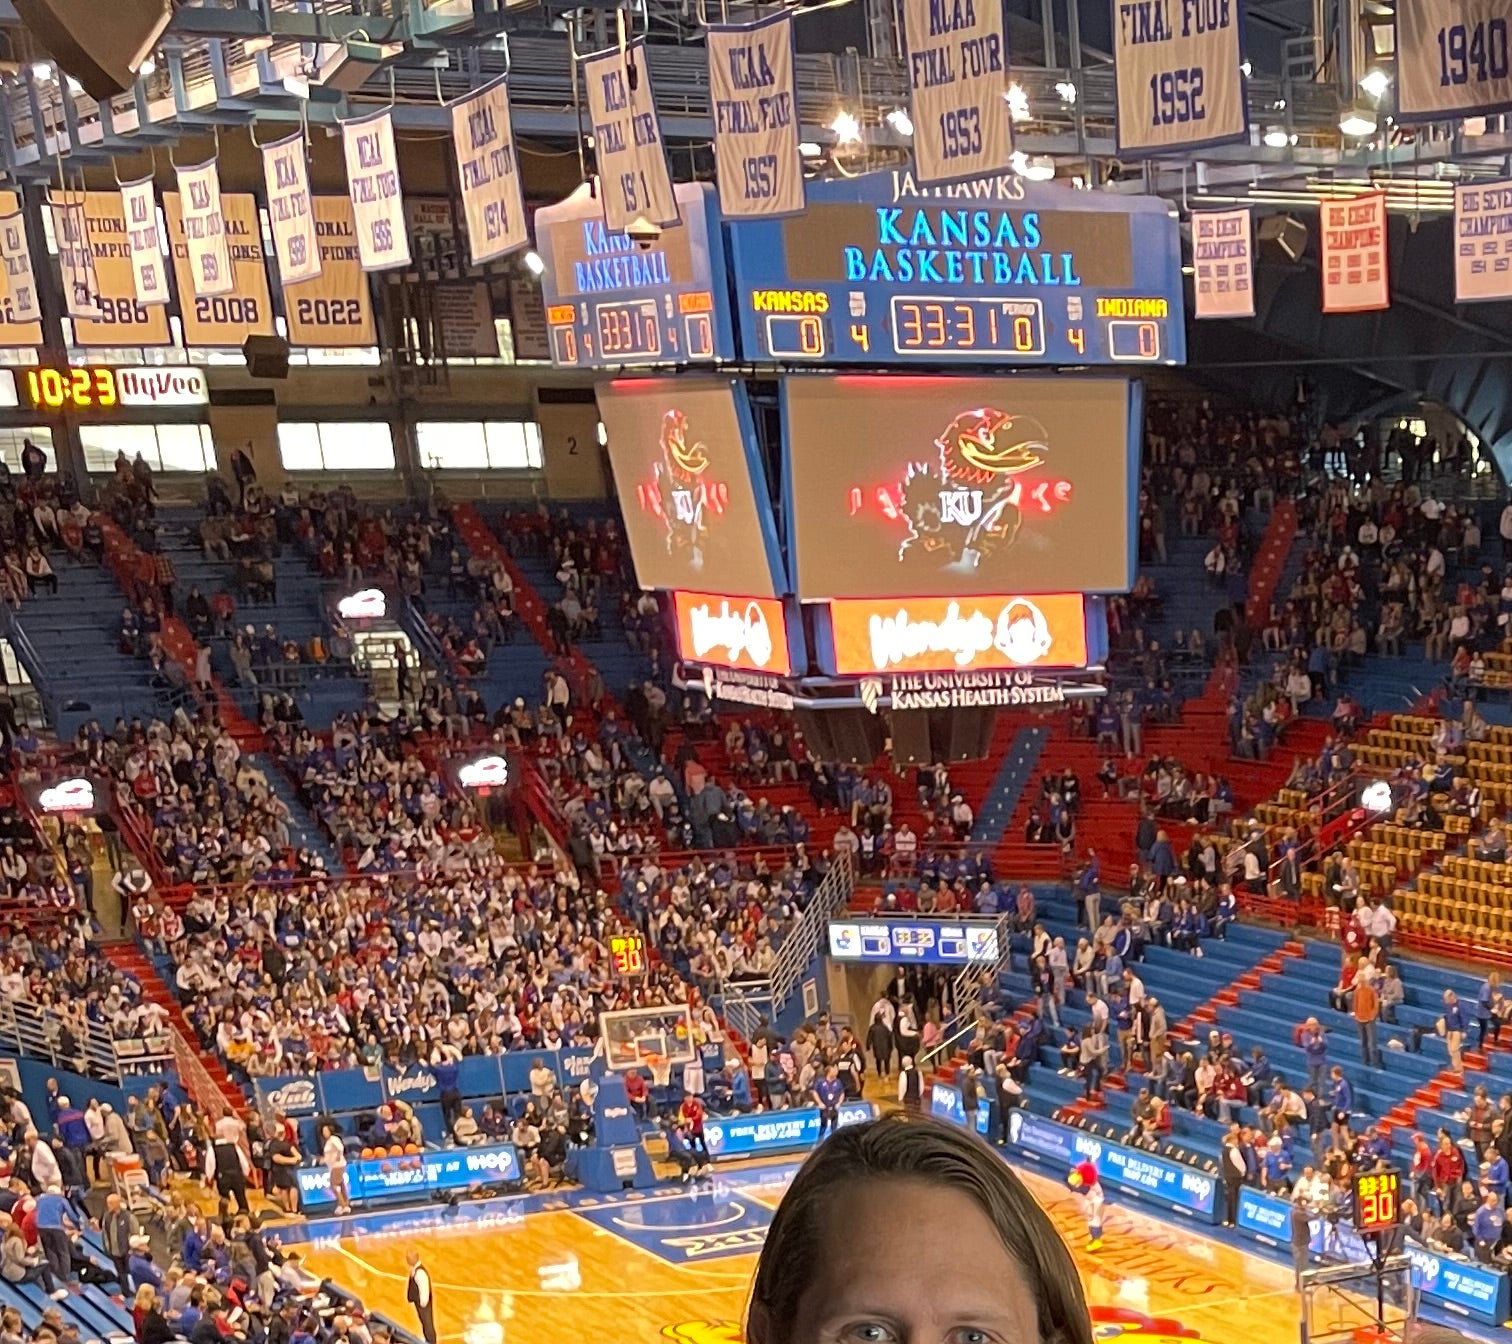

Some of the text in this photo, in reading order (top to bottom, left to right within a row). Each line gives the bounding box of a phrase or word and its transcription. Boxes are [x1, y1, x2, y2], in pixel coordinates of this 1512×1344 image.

[729, 44, 775, 90] NCAA
[912, 33, 1002, 89] FINAL FOUR
[1438, 19, 1510, 88] 1940
[1150, 67, 1206, 126] 1952
[718, 99, 760, 133] FINAL
[940, 106, 983, 160] 1953
[742, 154, 778, 200] 1957
[1461, 191, 1480, 213] BIG
[876, 207, 1041, 249] KANSAS
[1326, 227, 1380, 251] CHAMPIONS
[844, 245, 1081, 287] BASKETBALL
[1197, 240, 1248, 260] CHAMPIONS
[574, 251, 671, 293] BASKETBALL
[194, 297, 259, 323] 2008
[298, 299, 363, 325] 2022
[753, 290, 829, 313] KANSAS
[1096, 297, 1169, 318] INDIANA
[800, 316, 820, 354] 0
[850, 324, 871, 353] 4
[902, 303, 999, 347] 33:31
[1013, 317, 1034, 352] 0
[1067, 327, 1086, 354] 4
[1137, 323, 1159, 357] 0
[28, 368, 116, 406] 10:23
[568, 436, 579, 456] 2
[938, 490, 983, 527] KU
[892, 669, 1034, 690] THE UNIVERSITY OF
[892, 686, 1065, 710] KANSAS HEALTH SYSTEM
[1358, 1174, 1397, 1196] 33:31
[1363, 1193, 1394, 1225] 30
